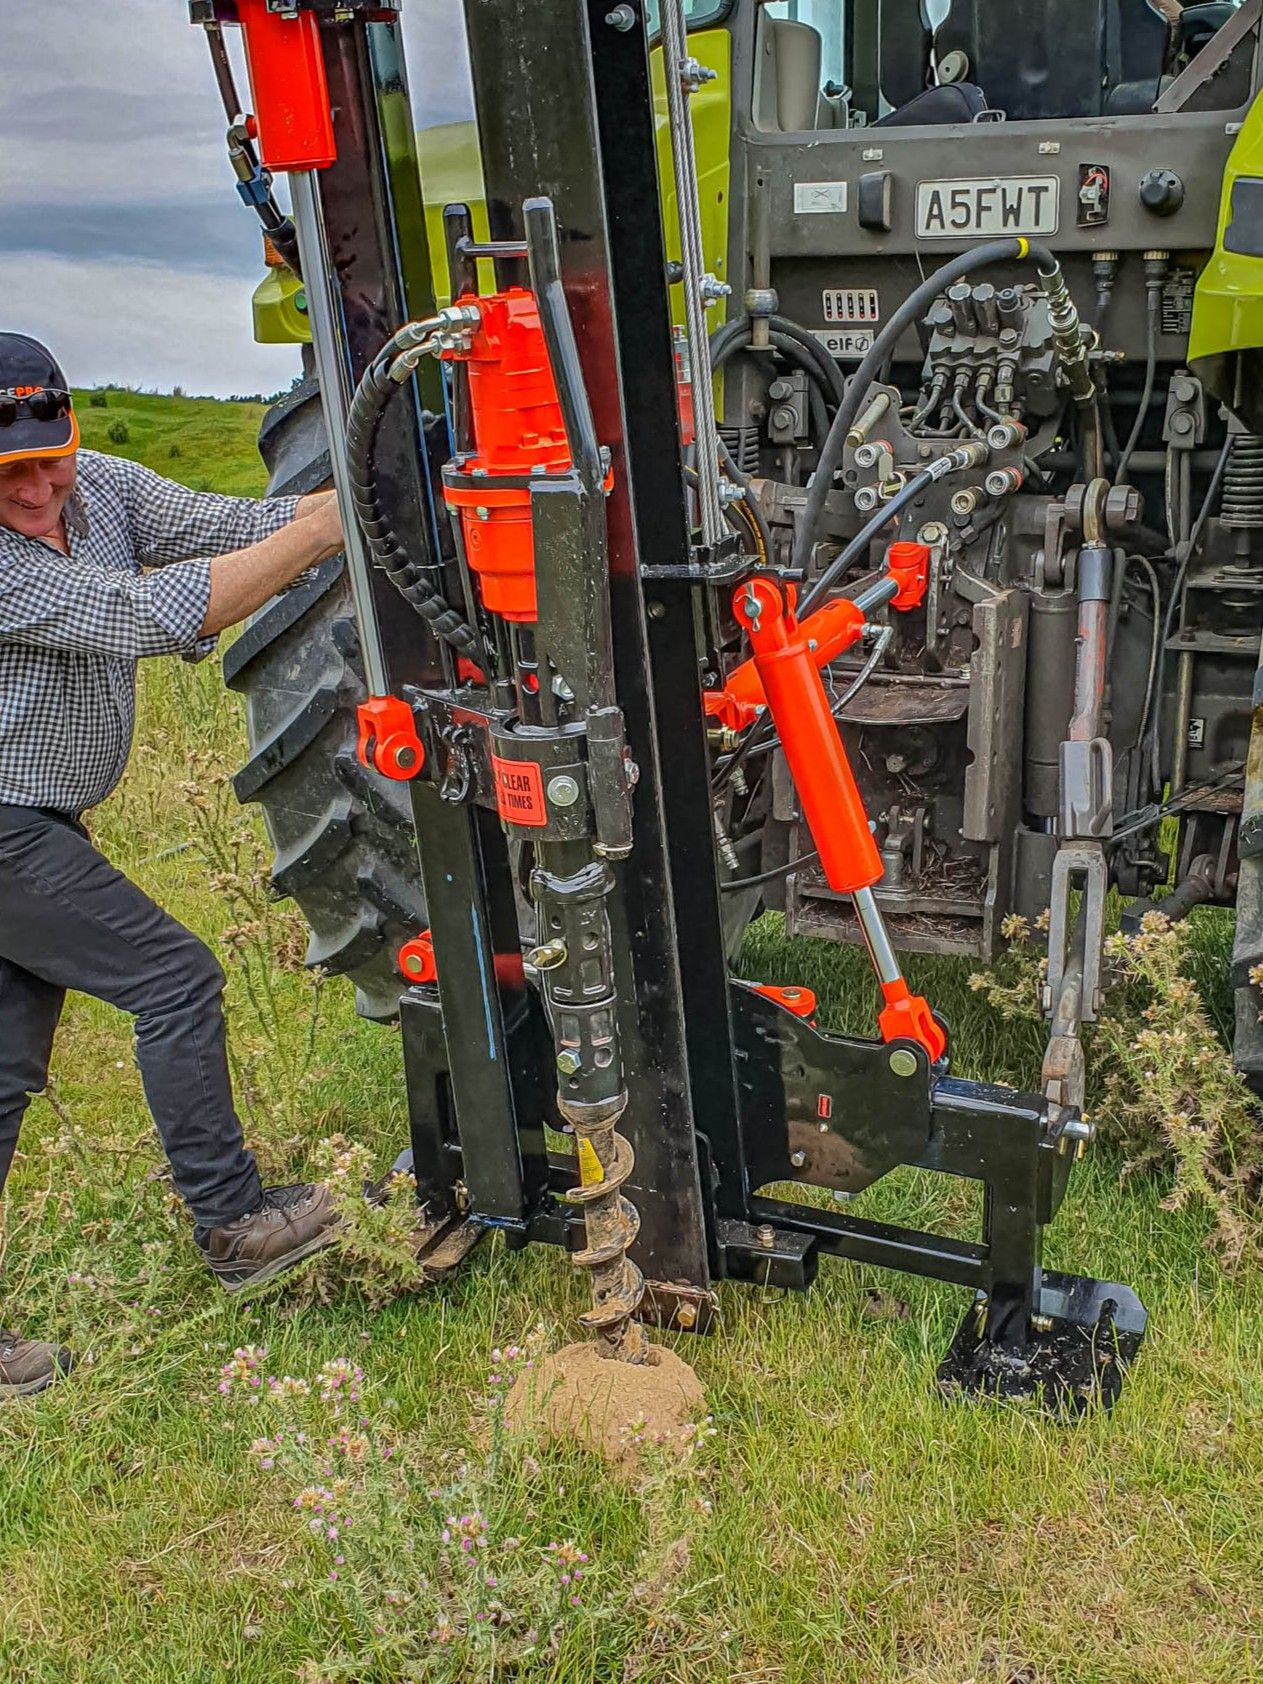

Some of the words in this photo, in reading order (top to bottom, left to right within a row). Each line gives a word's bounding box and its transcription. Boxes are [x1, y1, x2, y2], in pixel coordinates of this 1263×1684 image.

[925, 186, 1049, 230] A5FWT
[502, 772, 531, 792] CLEAR
[507, 792, 533, 810] TIMES
